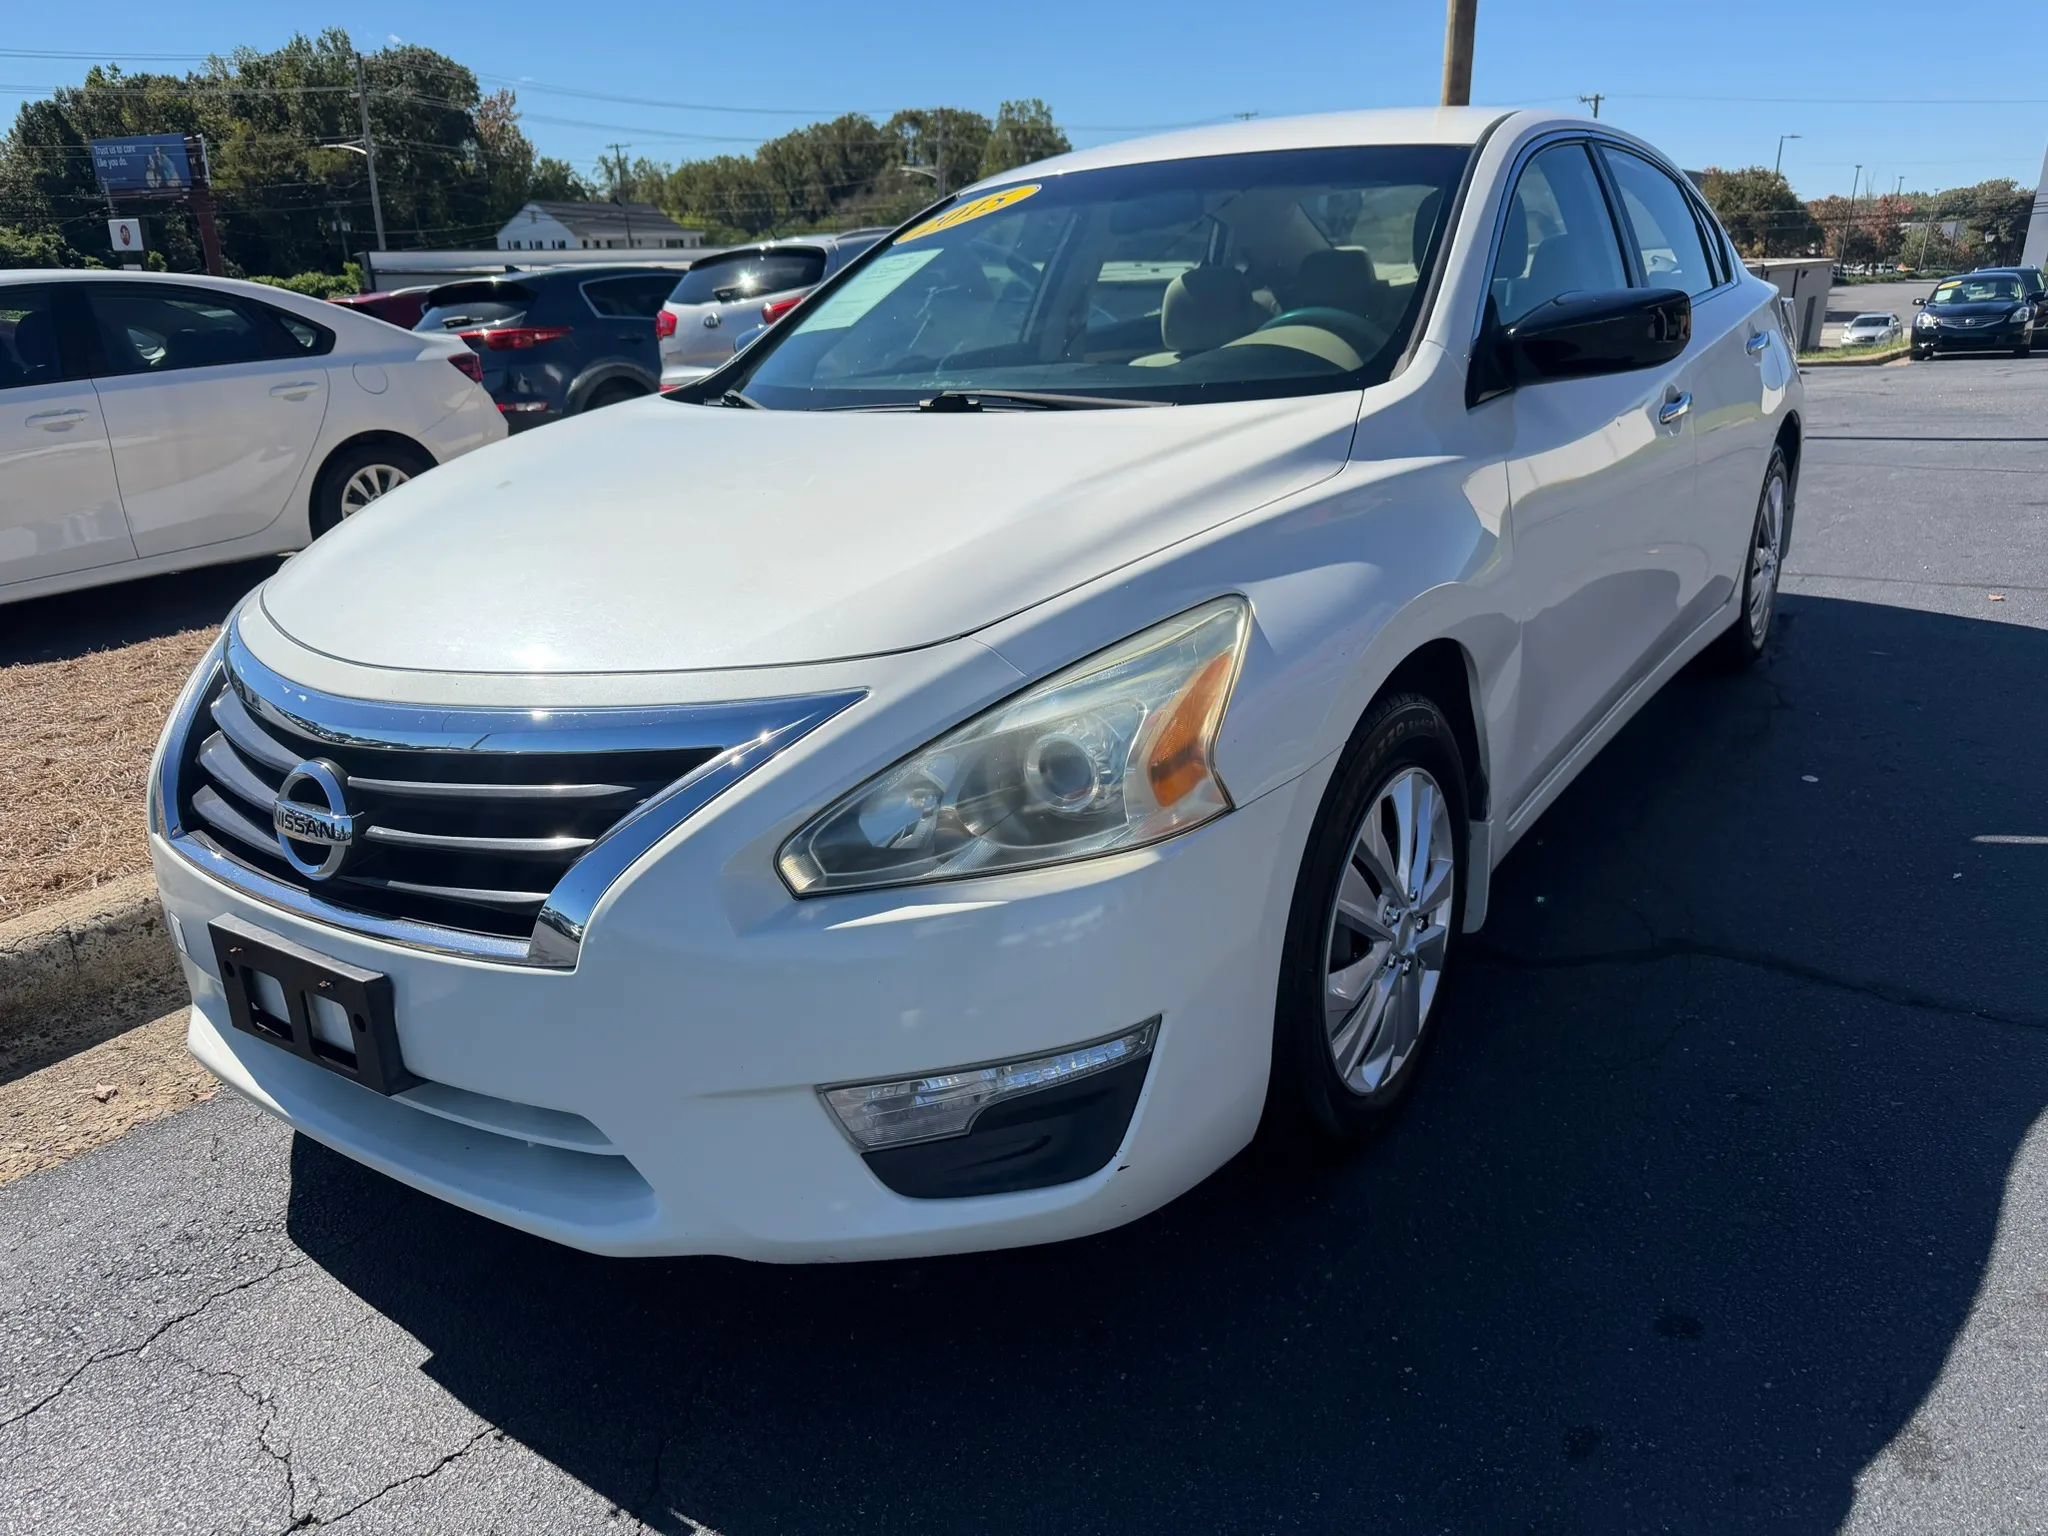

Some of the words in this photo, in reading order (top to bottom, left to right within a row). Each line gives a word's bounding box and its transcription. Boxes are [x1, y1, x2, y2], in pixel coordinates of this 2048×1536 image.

[94, 145, 109, 155] Trust
[109, 146, 116, 154] us
[123, 145, 136, 154] care
[108, 158, 119, 169] you
[276, 808, 336, 839] NISSAN
